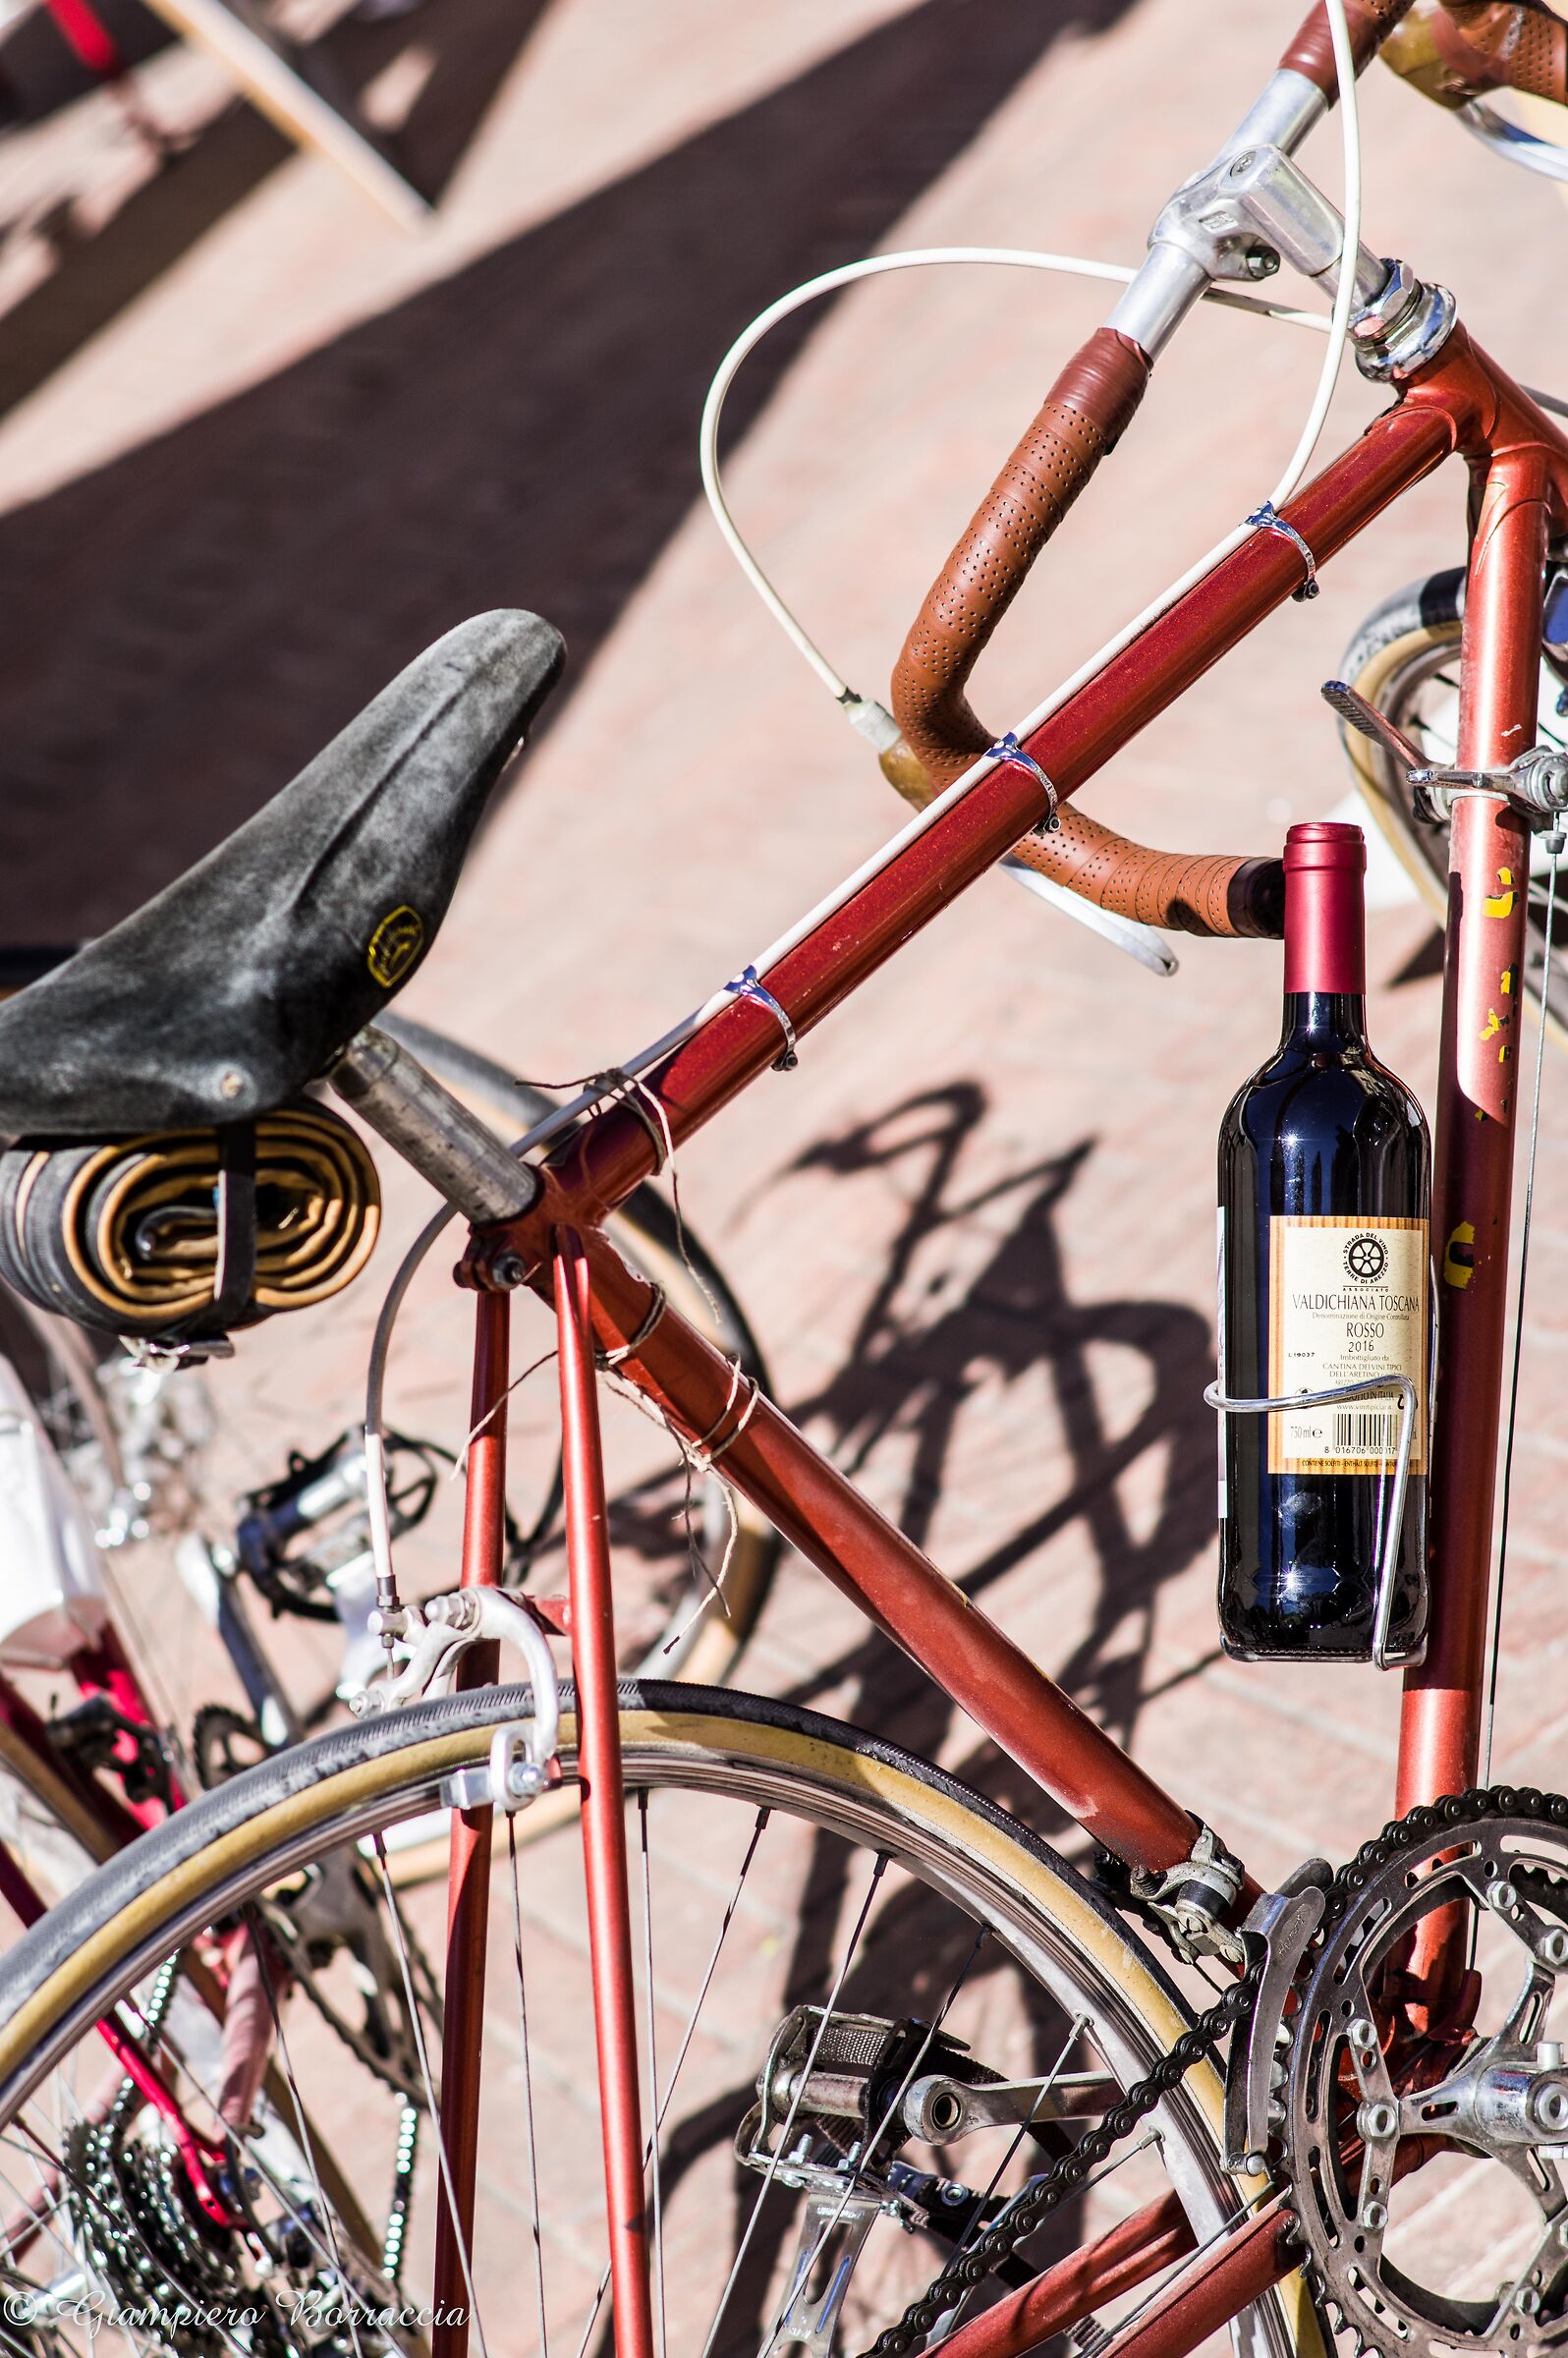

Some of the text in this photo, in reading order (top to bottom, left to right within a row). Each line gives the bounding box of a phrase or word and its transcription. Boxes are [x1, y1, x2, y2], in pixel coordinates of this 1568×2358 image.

[1342, 1232, 1364, 1254] STRADA
[1378, 1238, 1389, 1255] VINO
[1342, 1261, 1359, 1282] TERRE
[1370, 1263, 1389, 1284] AREZZO
[1293, 1294, 1420, 1312] VALDICHIANA TOSCANA
[1346, 1322, 1384, 1338] ROSSO
[1348, 1340, 1374, 1352] 2016
[1340, 1354, 1380, 1364] Imbottigliato
[1335, 1446, 1367, 1455] 016706
